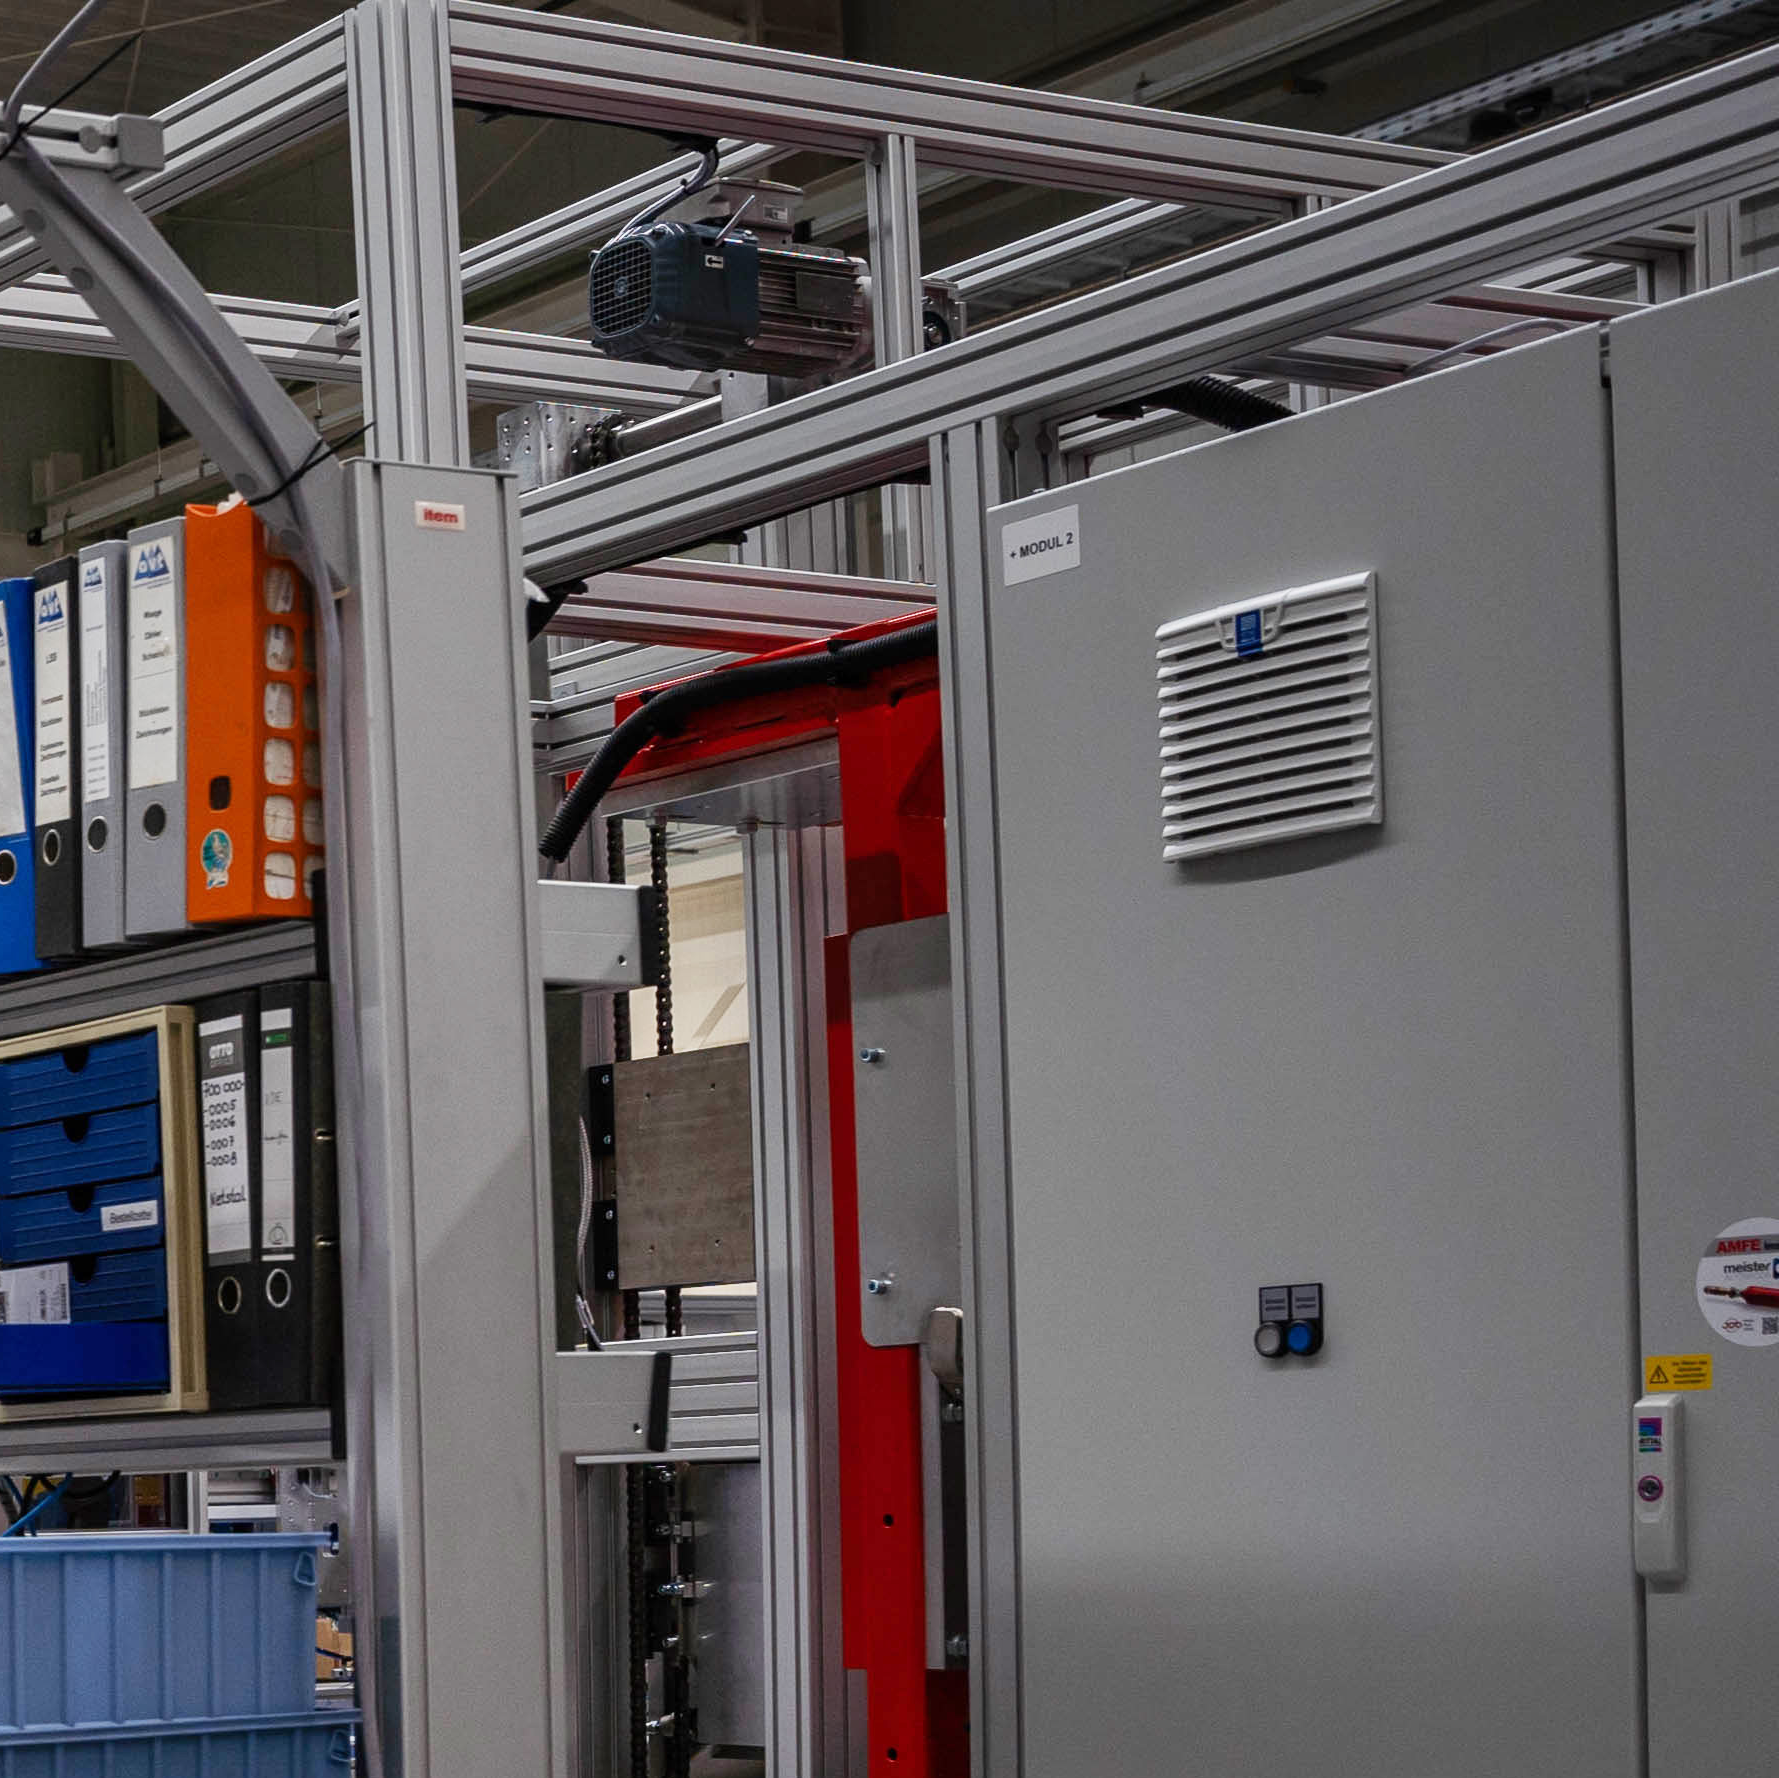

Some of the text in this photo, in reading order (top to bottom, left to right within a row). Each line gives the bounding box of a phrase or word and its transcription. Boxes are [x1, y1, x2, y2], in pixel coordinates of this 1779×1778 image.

[423, 508, 458, 523] item
[1019, 536, 1063, 558] MODUL
[1066, 532, 1074, 545] 2
[209, 1042, 234, 1059] OTTO
[1716, 1238, 1762, 1254] AMFE
[1723, 1261, 1771, 1274] meister
